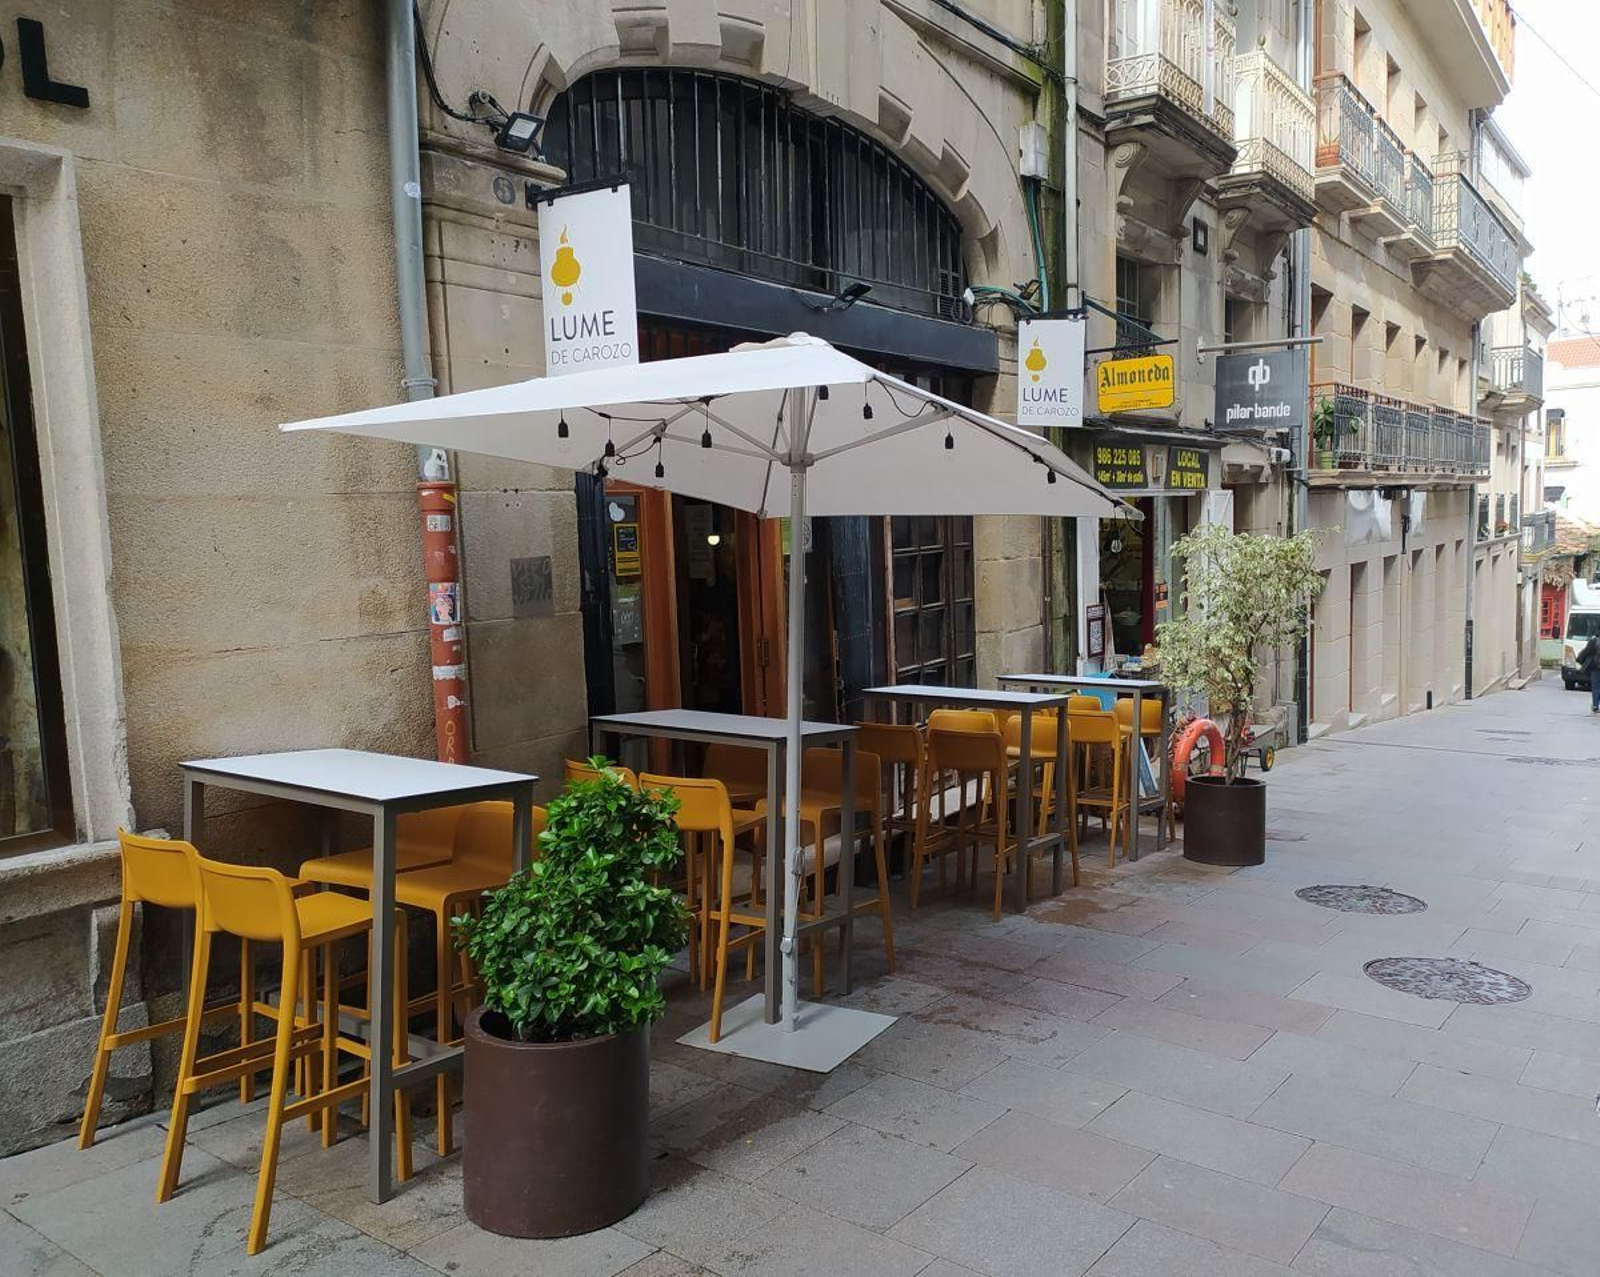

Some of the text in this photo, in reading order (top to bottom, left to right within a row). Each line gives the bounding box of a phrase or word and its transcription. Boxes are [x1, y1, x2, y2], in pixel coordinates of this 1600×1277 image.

[551, 310, 615, 341] LUME
[551, 342, 632, 364] DE CAROZO
[1101, 364, 1170, 394] Almoneda
[1023, 387, 1069, 403] LUME
[1022, 406, 1079, 417] DE CAROZO
[1226, 401, 1292, 424] pilar bande
[1097, 447, 1112, 465] 986
[1113, 448, 1127, 465] 225
[1177, 450, 1201, 469] LOCAL
[1171, 469, 1206, 489] EN VENTA
